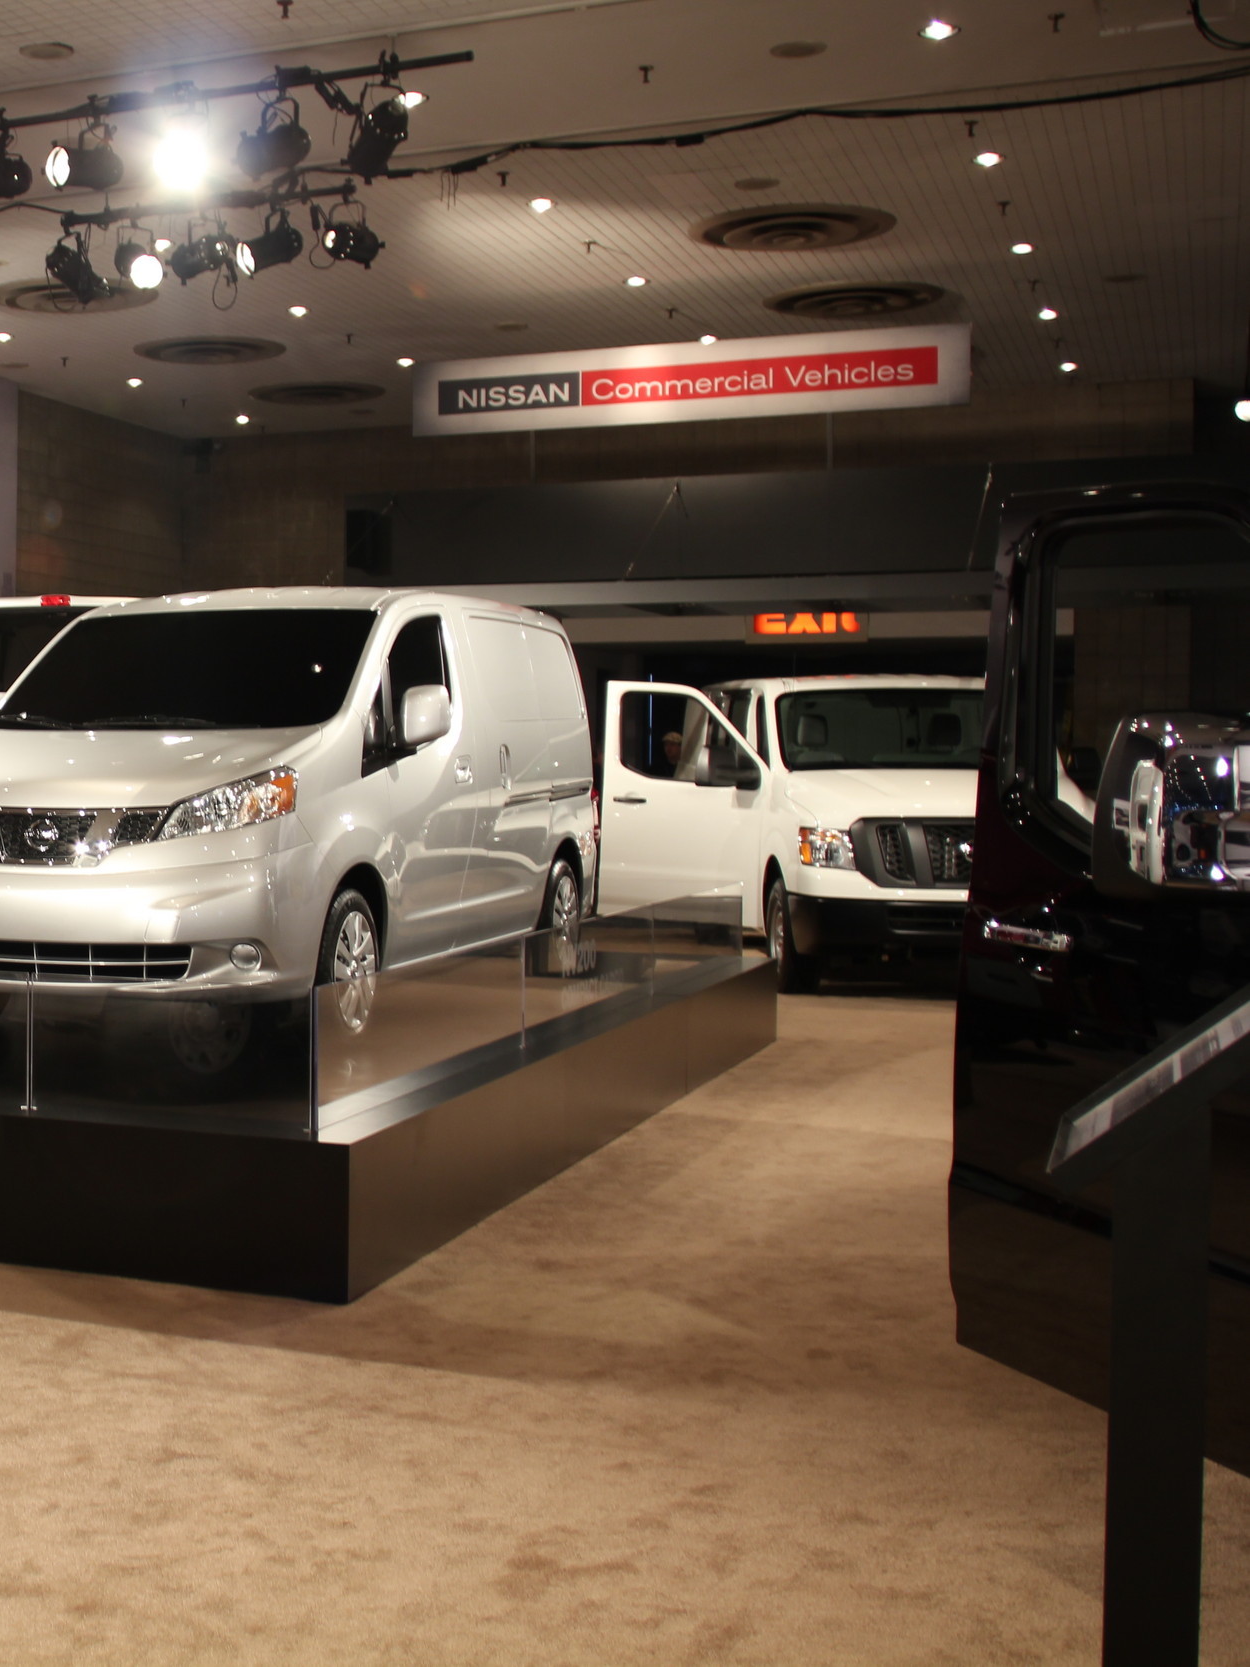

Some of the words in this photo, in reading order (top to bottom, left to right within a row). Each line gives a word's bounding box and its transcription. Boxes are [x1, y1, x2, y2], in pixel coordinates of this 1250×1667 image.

[457, 382, 571, 410] NISSAN
[591, 365, 774, 402] Commercial
[783, 358, 915, 388] Vehicles
